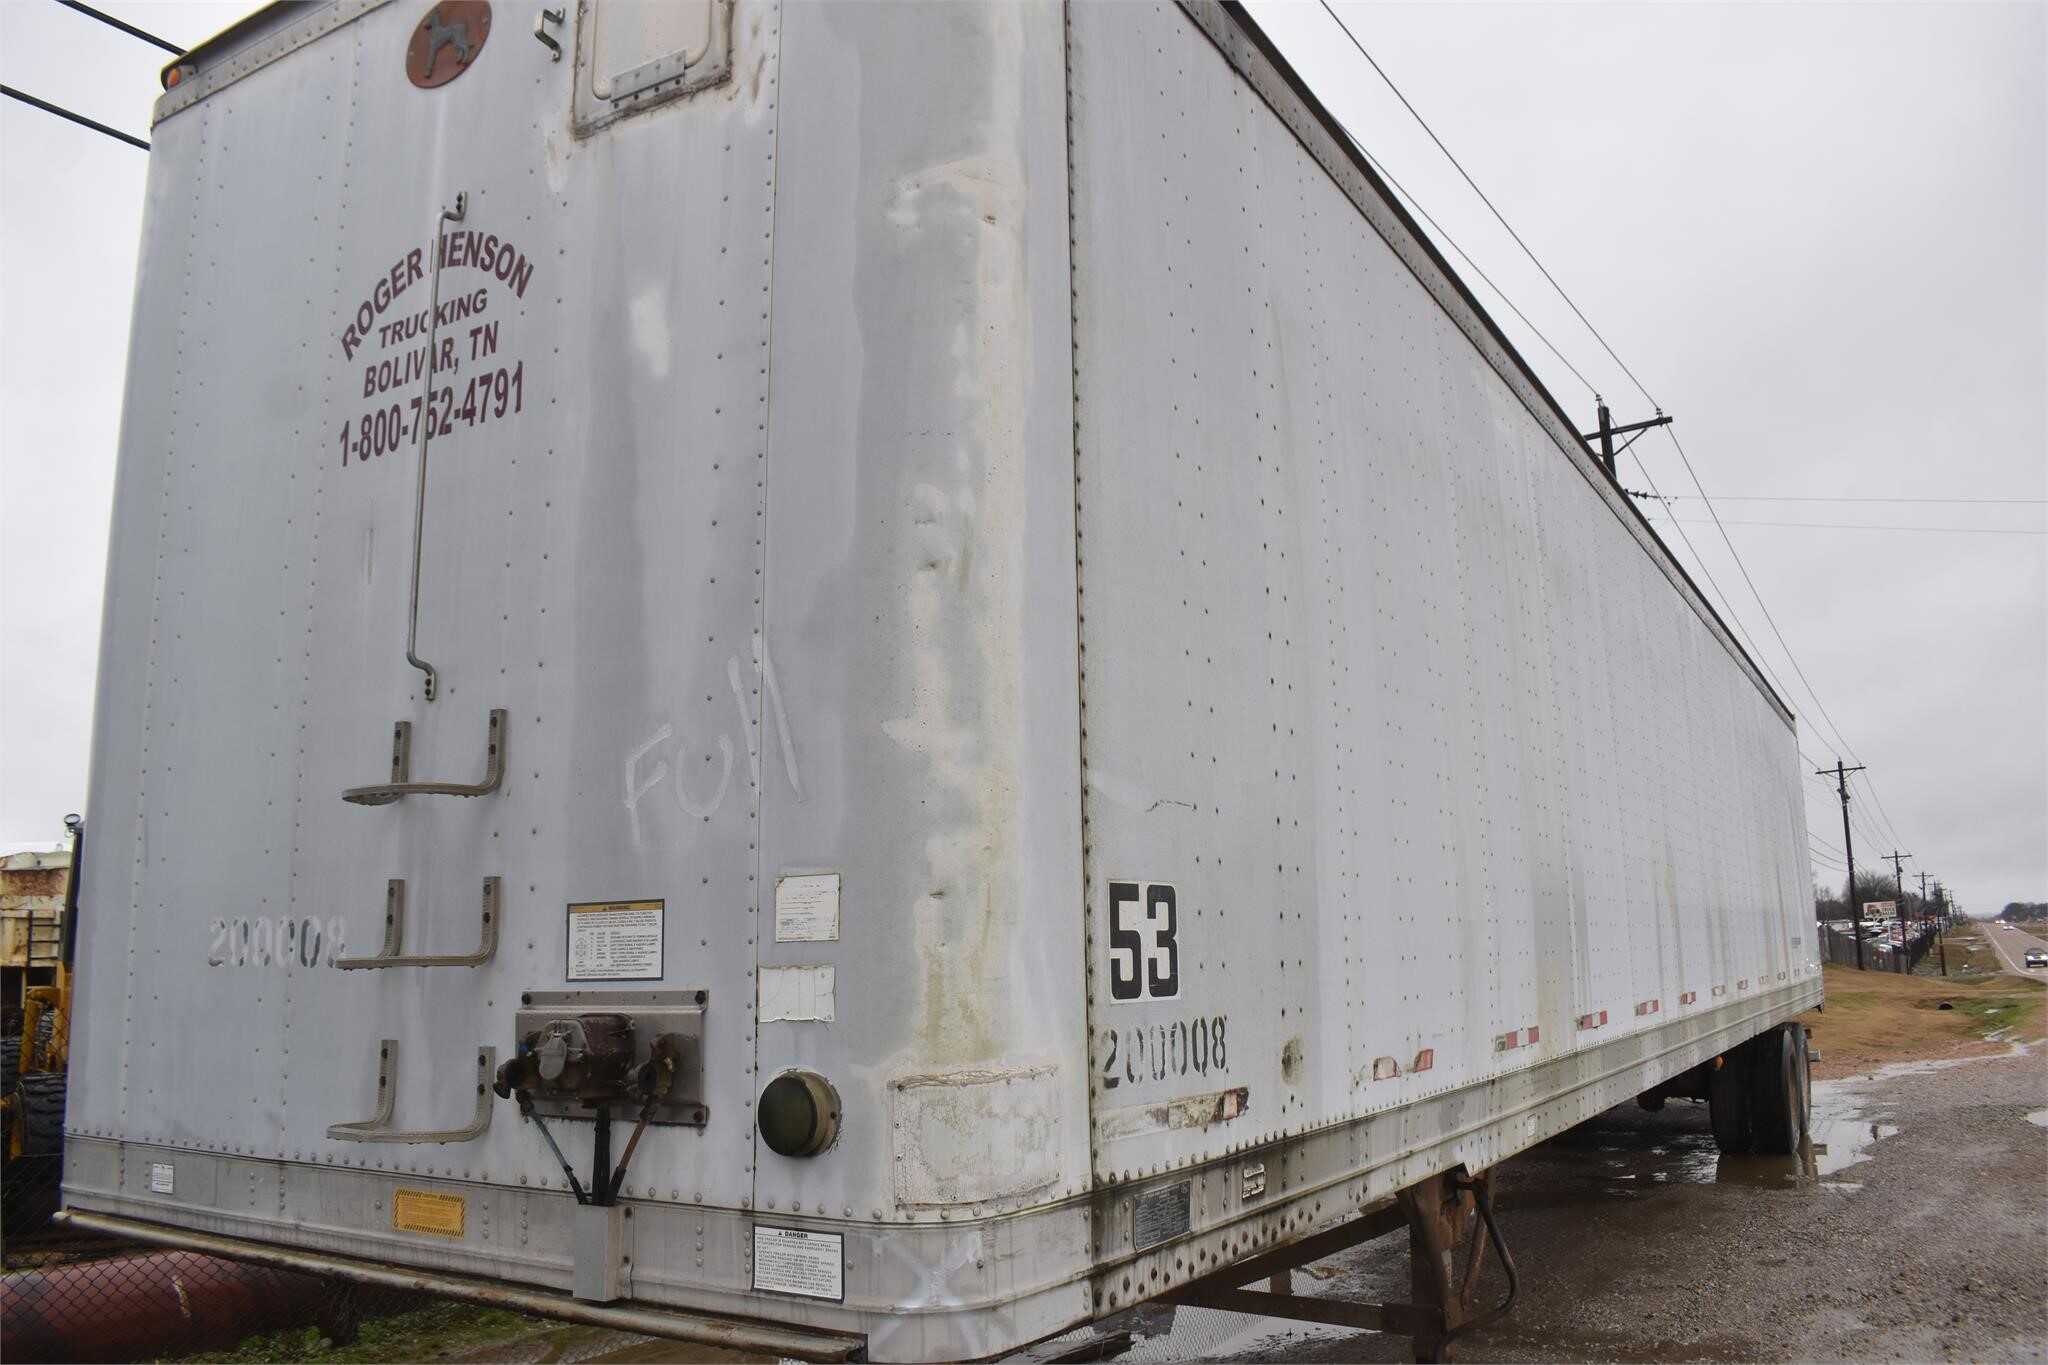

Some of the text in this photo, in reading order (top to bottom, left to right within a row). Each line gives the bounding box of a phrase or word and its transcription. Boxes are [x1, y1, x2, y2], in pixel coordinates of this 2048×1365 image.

[340, 247, 424, 363] ROGER
[378, 287, 488, 349] TRUCKING
[362, 320, 499, 400] BOLIVAR, TN
[339, 360, 524, 468] 1-800-752-4791
[1108, 881, 1179, 1001] 53
[1102, 1015, 1227, 1089] 200008
[785, 1231, 808, 1239] DANGER
